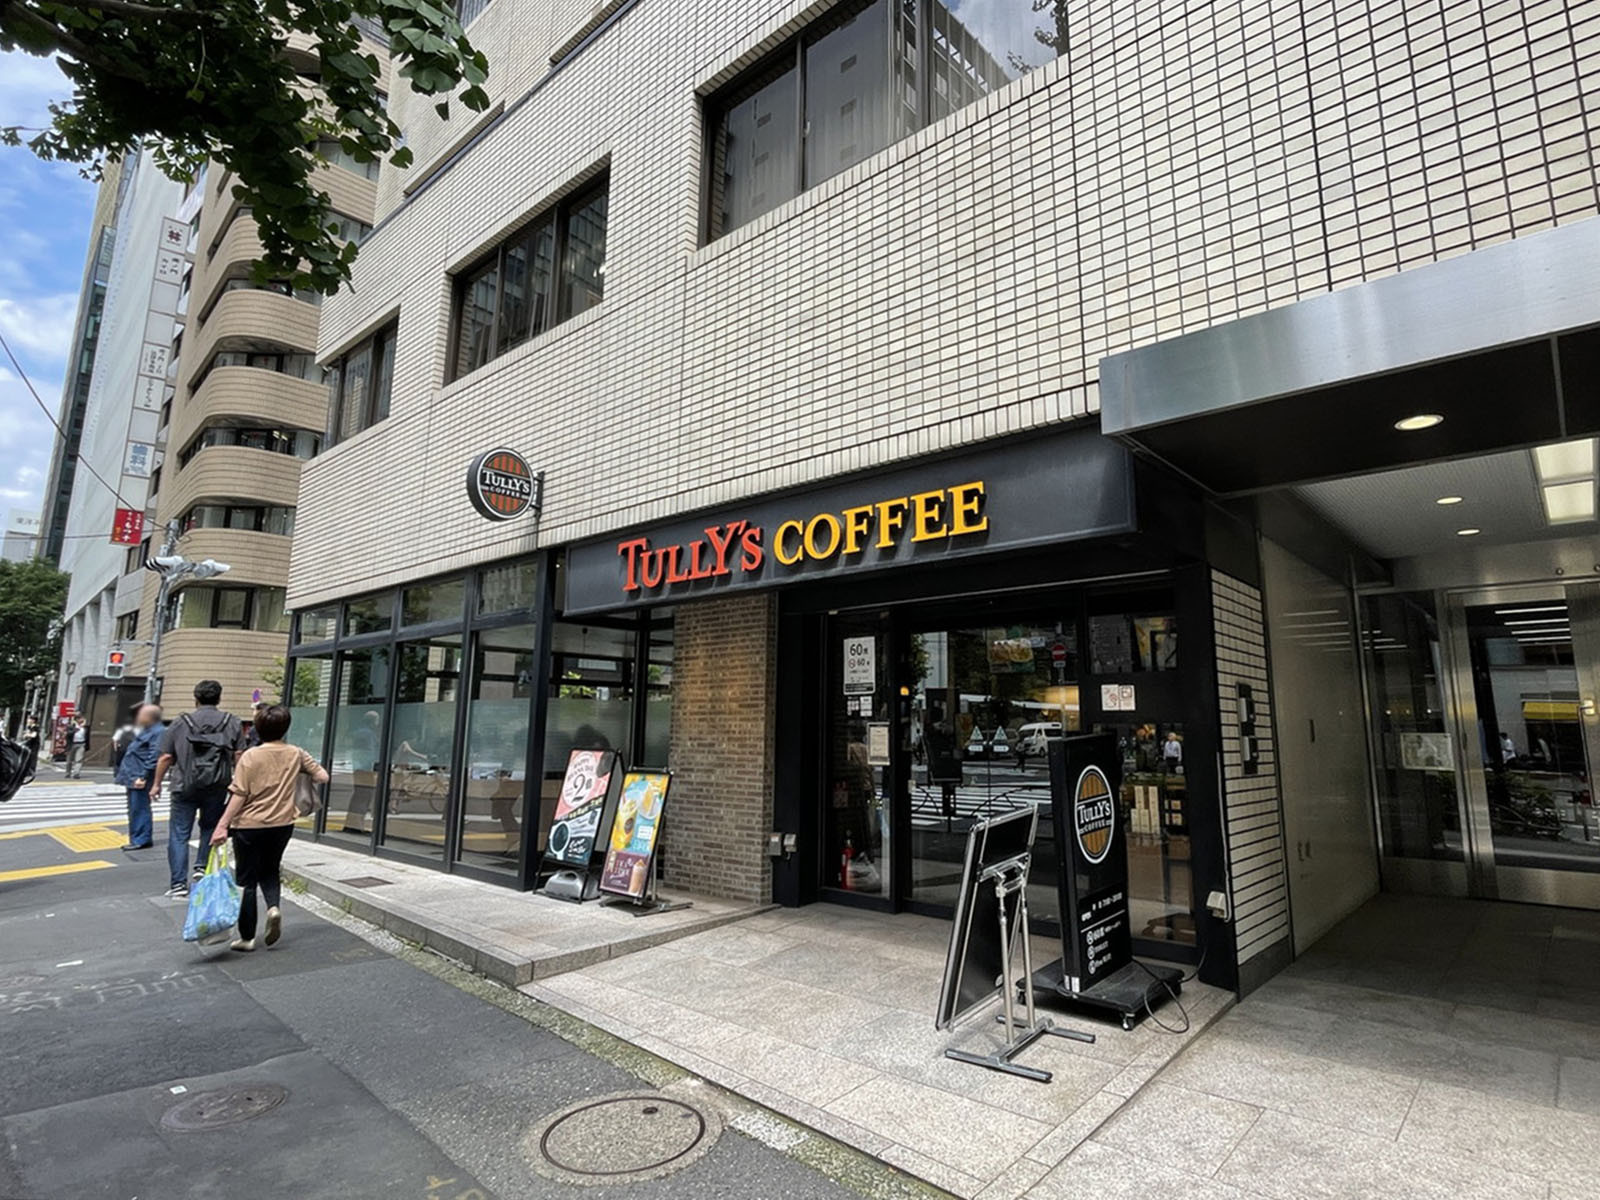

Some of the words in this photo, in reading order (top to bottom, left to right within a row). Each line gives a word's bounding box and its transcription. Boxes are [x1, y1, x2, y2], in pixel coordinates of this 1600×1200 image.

[482, 470, 530, 494] TULLY'S
[489, 486, 521, 498] COFFEE
[617, 519, 763, 592] TULLY'S
[773, 481, 988, 566] COFFEE
